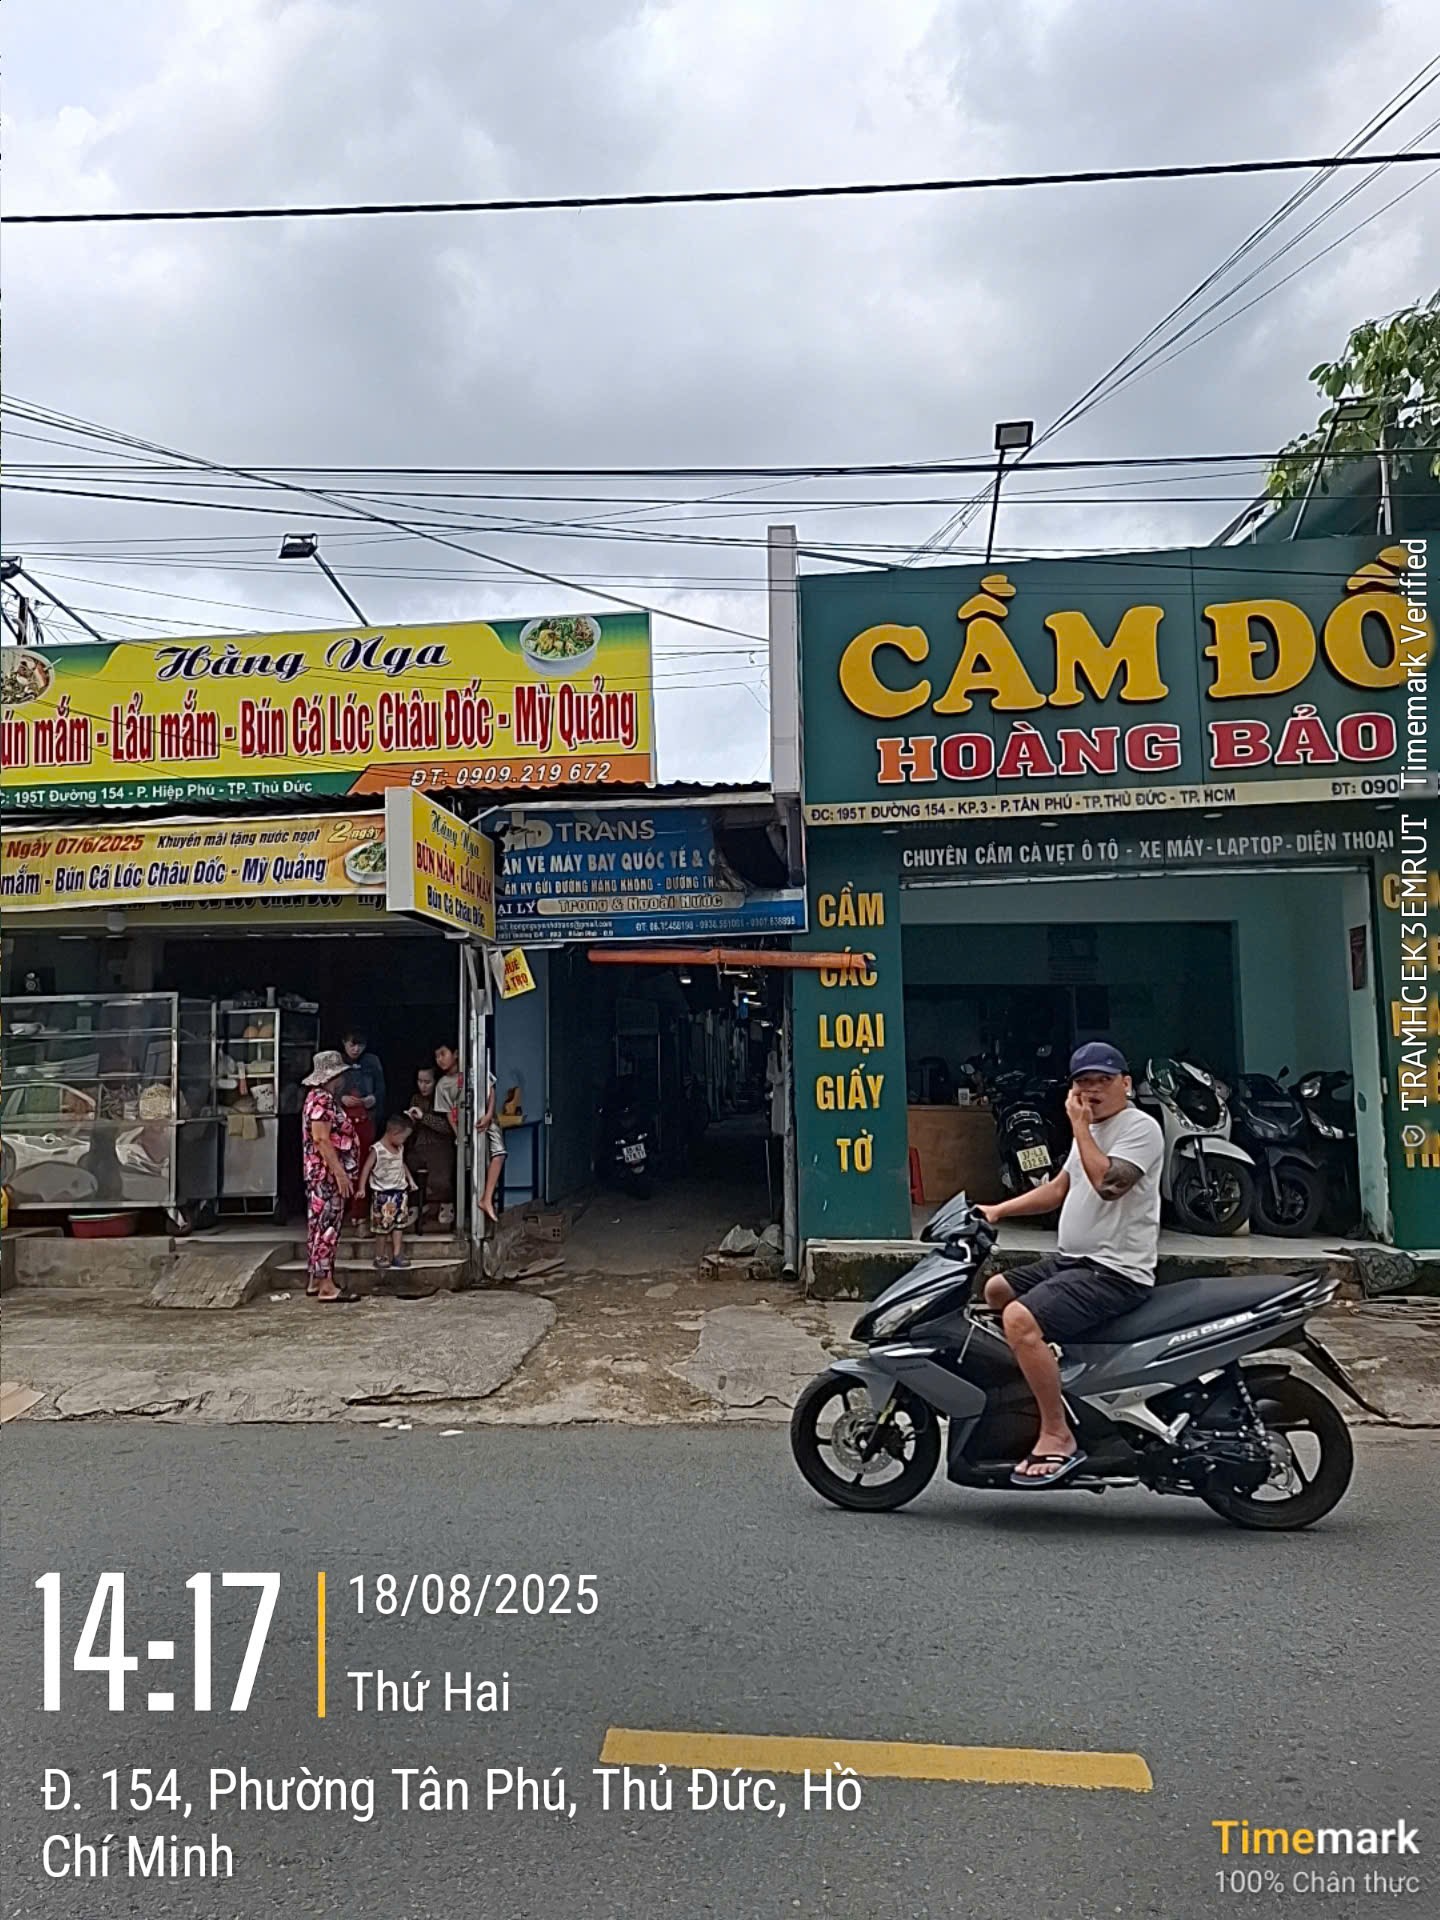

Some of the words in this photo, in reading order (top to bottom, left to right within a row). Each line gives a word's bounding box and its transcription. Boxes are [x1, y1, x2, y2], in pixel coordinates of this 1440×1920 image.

[154, 643, 312, 682] Hằng
[324, 635, 451, 677] Nga
[838, 573, 1169, 718] CẦM
[1, 708, 29, 769] ún
[33, 695, 91, 767] mắm
[112, 691, 154, 762] Lẩu
[160, 688, 219, 761] mắm
[240, 697, 288, 758] Bún
[292, 695, 325, 756] Cá
[328, 692, 373, 754] Lóc
[377, 687, 440, 752] Châu
[445, 677, 494, 749] Đốc
[514, 683, 554, 752] Mỳ
[557, 675, 637, 751] Quảng
[876, 720, 1182, 784] HOÀNG
[1208, 704, 1398, 769] BẢO
[14, 790, 45, 804] 195T
[49, 788, 97, 803] Đường
[101, 786, 124, 800] 154
[137, 786, 148, 799] P.
[152, 784, 183, 800] Hiệp
[187, 783, 215, 797] Phú
[227, 782, 248, 796] TP.
[252, 780, 279, 794] Thủ
[283, 780, 313, 793] Đức
[410, 768, 449, 787] ĐT:
[456, 762, 562, 785] 0909.219
[568, 762, 612, 781] 672
[1331, 782, 1357, 796] ĐT:
[811, 808, 834, 821] ĐC:
[836, 806, 866, 820] 195T
[871, 802, 920, 818] ĐƯỜNG
[925, 803, 946, 816] 154
[958, 800, 988, 814] KP.3
[1044, 793, 1073, 810] PHÚ
[1135, 788, 1167, 806] ĐỨC
[1180, 789, 1200, 803] TP.
[1204, 788, 1236, 803] HCM
[6, 839, 52, 860] Ngày
[55, 834, 146, 855] 07/6/2025
[328, 820, 354, 844] 2
[555, 819, 656, 842] TRANS
[903, 845, 967, 868] CHUYÊN
[975, 840, 1013, 865] CẦM
[1019, 842, 1042, 863] CÀ
[1044, 843, 1075, 866] VẸT
[1081, 839, 1093, 861] Ô
[1097, 838, 1119, 860] TÔ
[1139, 840, 1162, 858] XE
[1167, 835, 1204, 858] MÁY
[1217, 835, 1283, 856] LAPTOP
[1342, 830, 1394, 852] THOẠI
[55, 865, 85, 892] Bún
[88, 864, 112, 889] Cá
[114, 863, 144, 888] Lóc
[147, 860, 189, 887] Châu
[193, 856, 226, 884] Đốc
[241, 856, 269, 884] Mỳ
[272, 853, 328, 882] Quảng
[416, 838, 435, 876] BÚN
[550, 851, 583, 873] MÁY
[587, 853, 616, 872] BAY
[621, 847, 665, 870] QUỐC
[669, 844, 688, 868] TẾ
[818, 881, 884, 927] CẦM
[818, 1012, 885, 1054] LOẠI
[816, 1063, 885, 1111] GIẤY
[836, 1128, 874, 1174] TỜ
